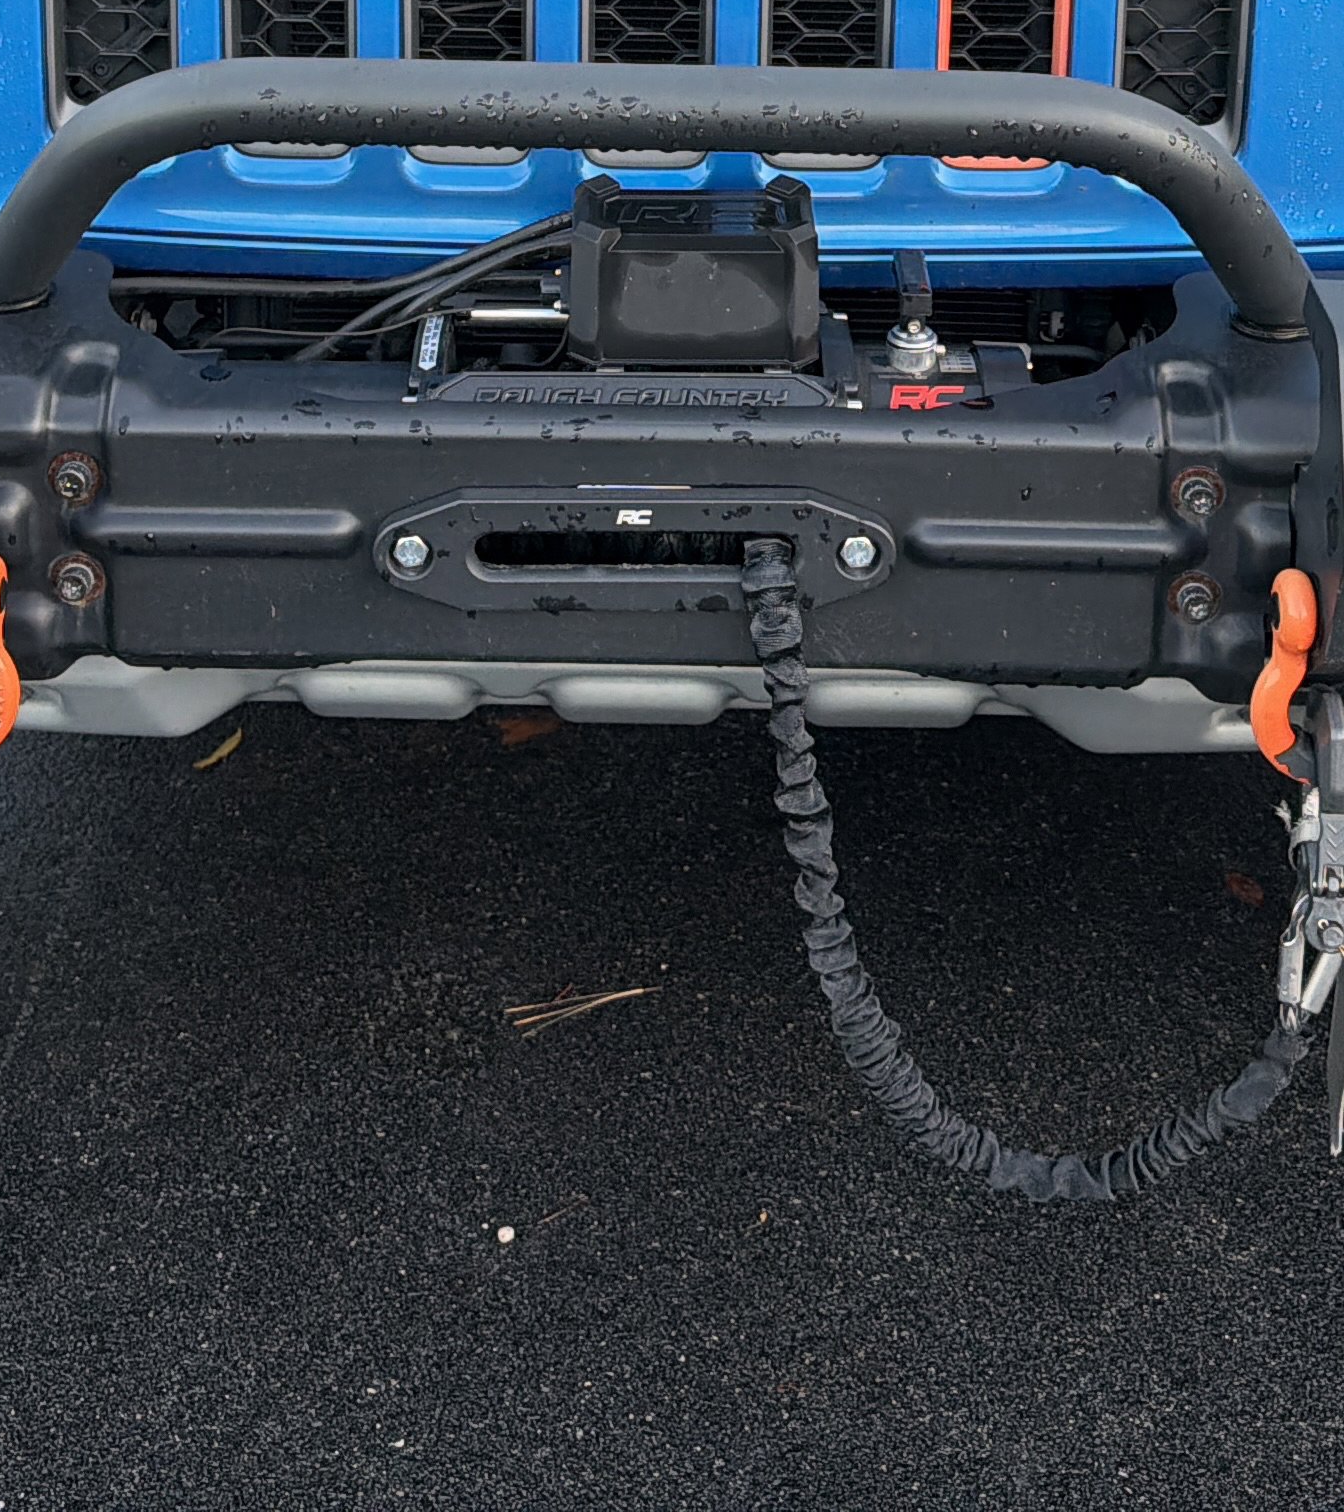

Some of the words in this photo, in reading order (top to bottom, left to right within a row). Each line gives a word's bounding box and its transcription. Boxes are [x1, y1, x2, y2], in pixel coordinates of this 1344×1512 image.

[611, 388, 790, 407] COUNTRY
[889, 384, 966, 410] RC
[616, 509, 653, 525] RC
